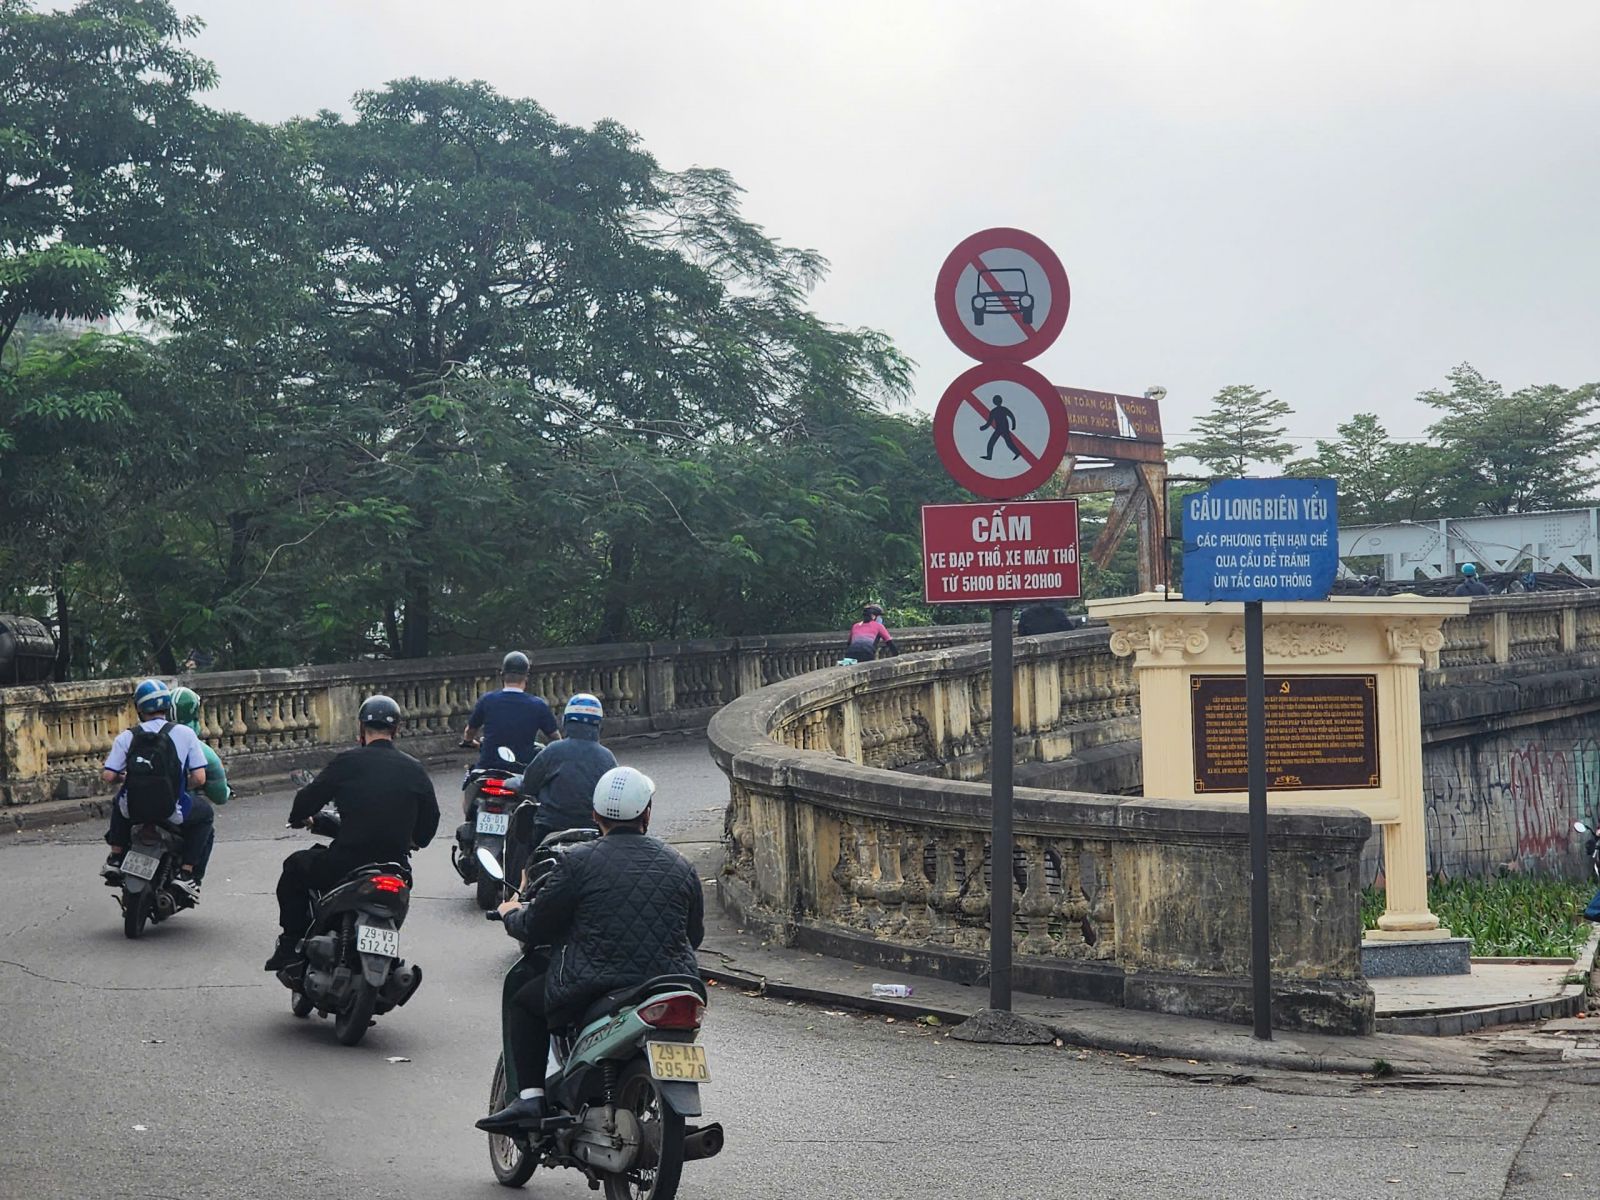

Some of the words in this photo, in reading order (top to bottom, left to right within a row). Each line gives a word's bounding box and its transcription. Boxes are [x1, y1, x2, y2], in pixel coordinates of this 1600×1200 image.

[1190, 491, 1221, 521] CẦU
[1225, 498, 1262, 520] LONG
[1264, 494, 1298, 520] BIÊN
[1303, 490, 1327, 520] YẾU
[971, 506, 1032, 542] CẤM
[1197, 532, 1217, 547] CÁC
[1220, 534, 1261, 547] PHƯƠNG
[1264, 531, 1285, 549] TIỆN
[1288, 534, 1307, 549] HẠN
[1311, 529, 1328, 547] CHẾ
[930, 552, 946, 568] XE
[949, 551, 974, 571] ĐẠP
[1005, 550, 1021, 566] XE
[1024, 546, 1049, 566] MÁY
[1215, 554, 1237, 568] QUA
[1240, 550, 1261, 568] CẦU
[1279, 552, 1310, 568] TRÁNH
[942, 573, 959, 592] TỪ
[962, 575, 994, 592] 5H00
[997, 569, 1021, 590] ĐẾN
[1024, 573, 1062, 590] 20H00
[1214, 572, 1228, 588] ÙN
[1231, 569, 1251, 588] TẮC
[1253, 575, 1278, 588] GIAO
[1280, 572, 1312, 588] THÔNG
[360, 938, 396, 956] 512.42
[655, 1061, 708, 1079] 695.70
